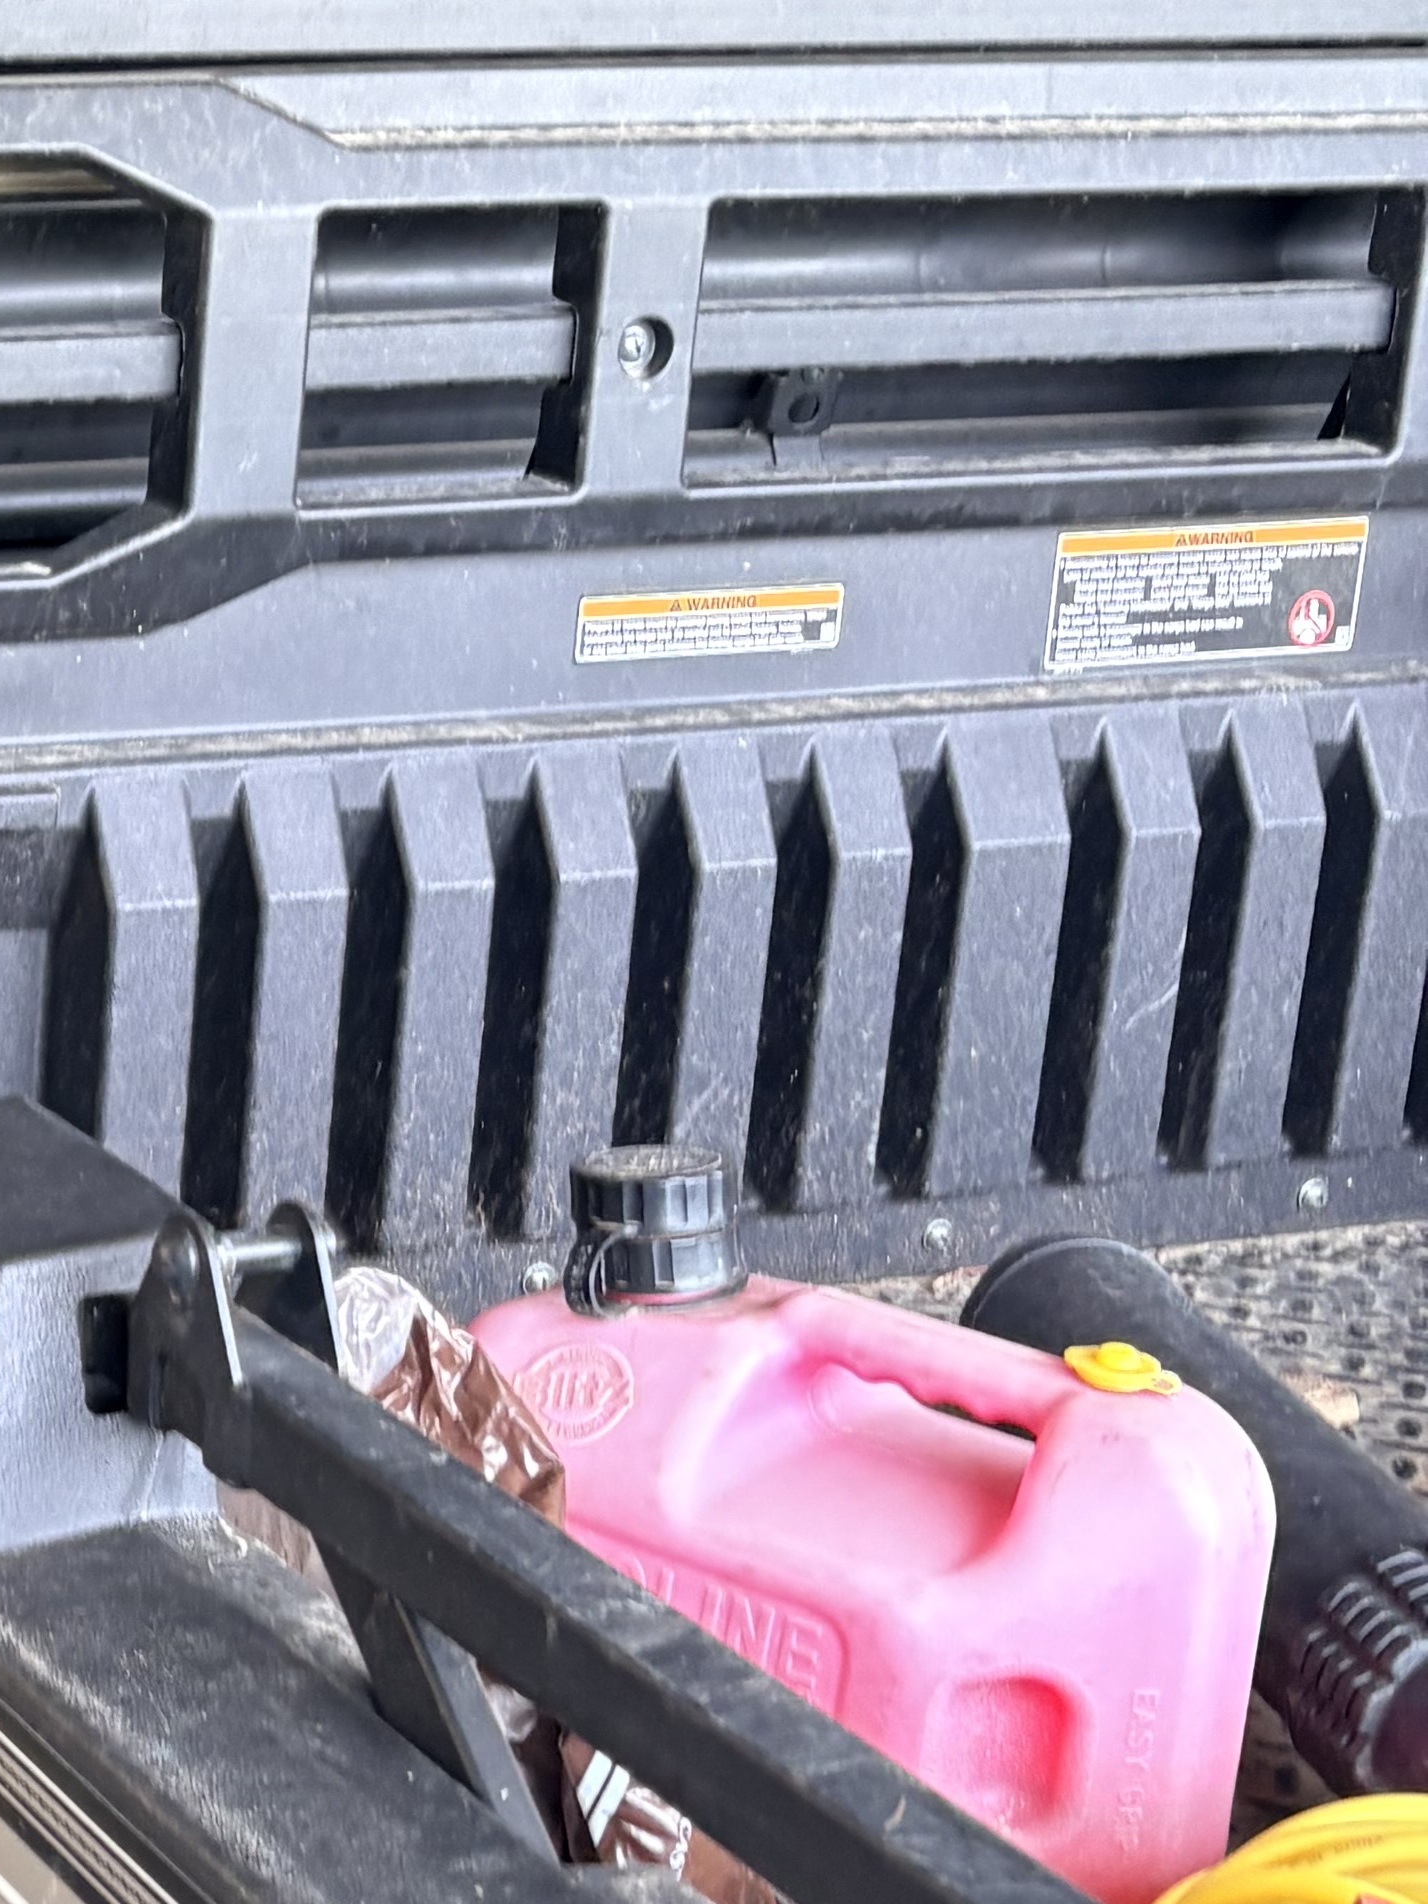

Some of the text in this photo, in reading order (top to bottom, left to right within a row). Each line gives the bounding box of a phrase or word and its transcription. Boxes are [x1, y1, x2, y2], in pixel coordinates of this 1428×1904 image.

[1187, 530, 1254, 545] WARNING
[687, 594, 757, 610] WARNING
[1125, 1688, 1160, 1770] EASY
